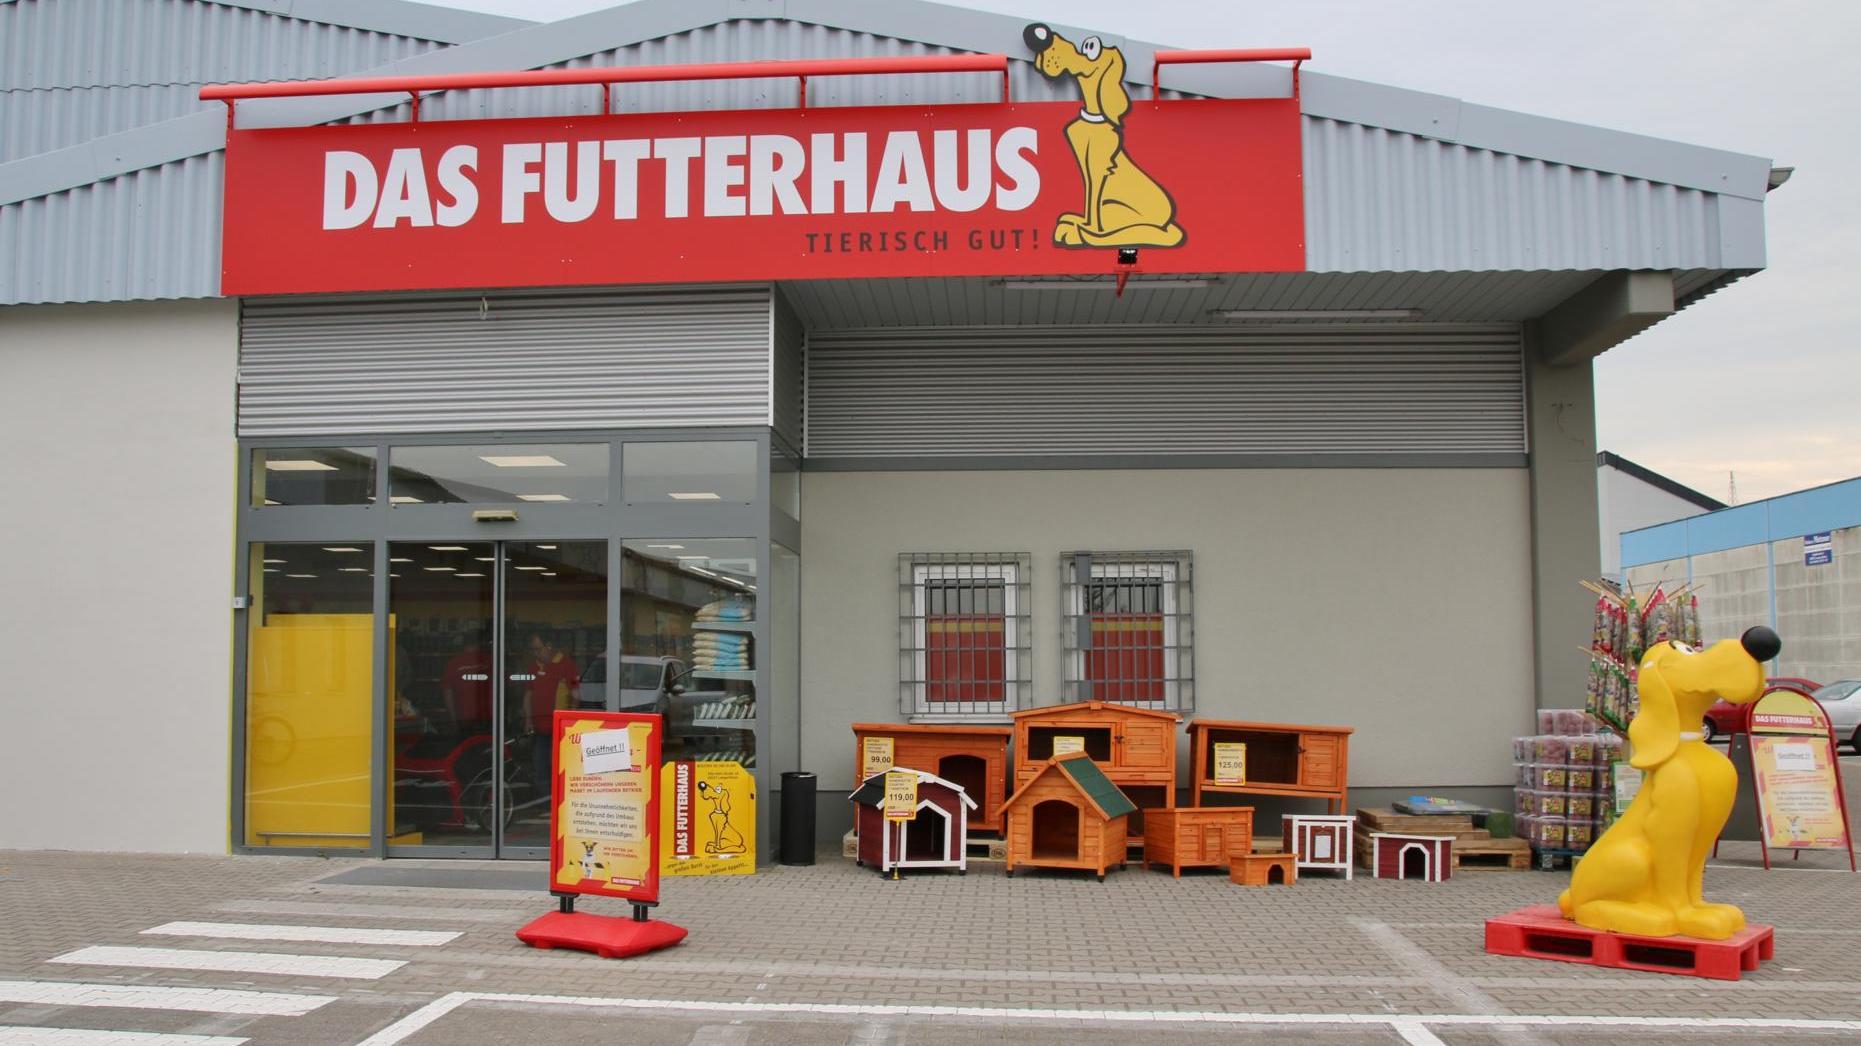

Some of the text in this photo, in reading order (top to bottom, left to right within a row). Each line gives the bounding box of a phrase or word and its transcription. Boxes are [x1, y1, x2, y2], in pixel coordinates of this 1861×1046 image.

[323, 127, 1040, 230] DAS FUTTERHAUS
[805, 229, 1039, 252] TIERISCH GUT!
[1770, 715, 1813, 724] FUTTERHAUS
[586, 744, 617, 755] Geöffnet
[871, 756, 891, 764] 99,00
[676, 764, 689, 830] FUTTERHAUS
[889, 793, 914, 802] 119,00
[676, 832, 688, 853] DAS
